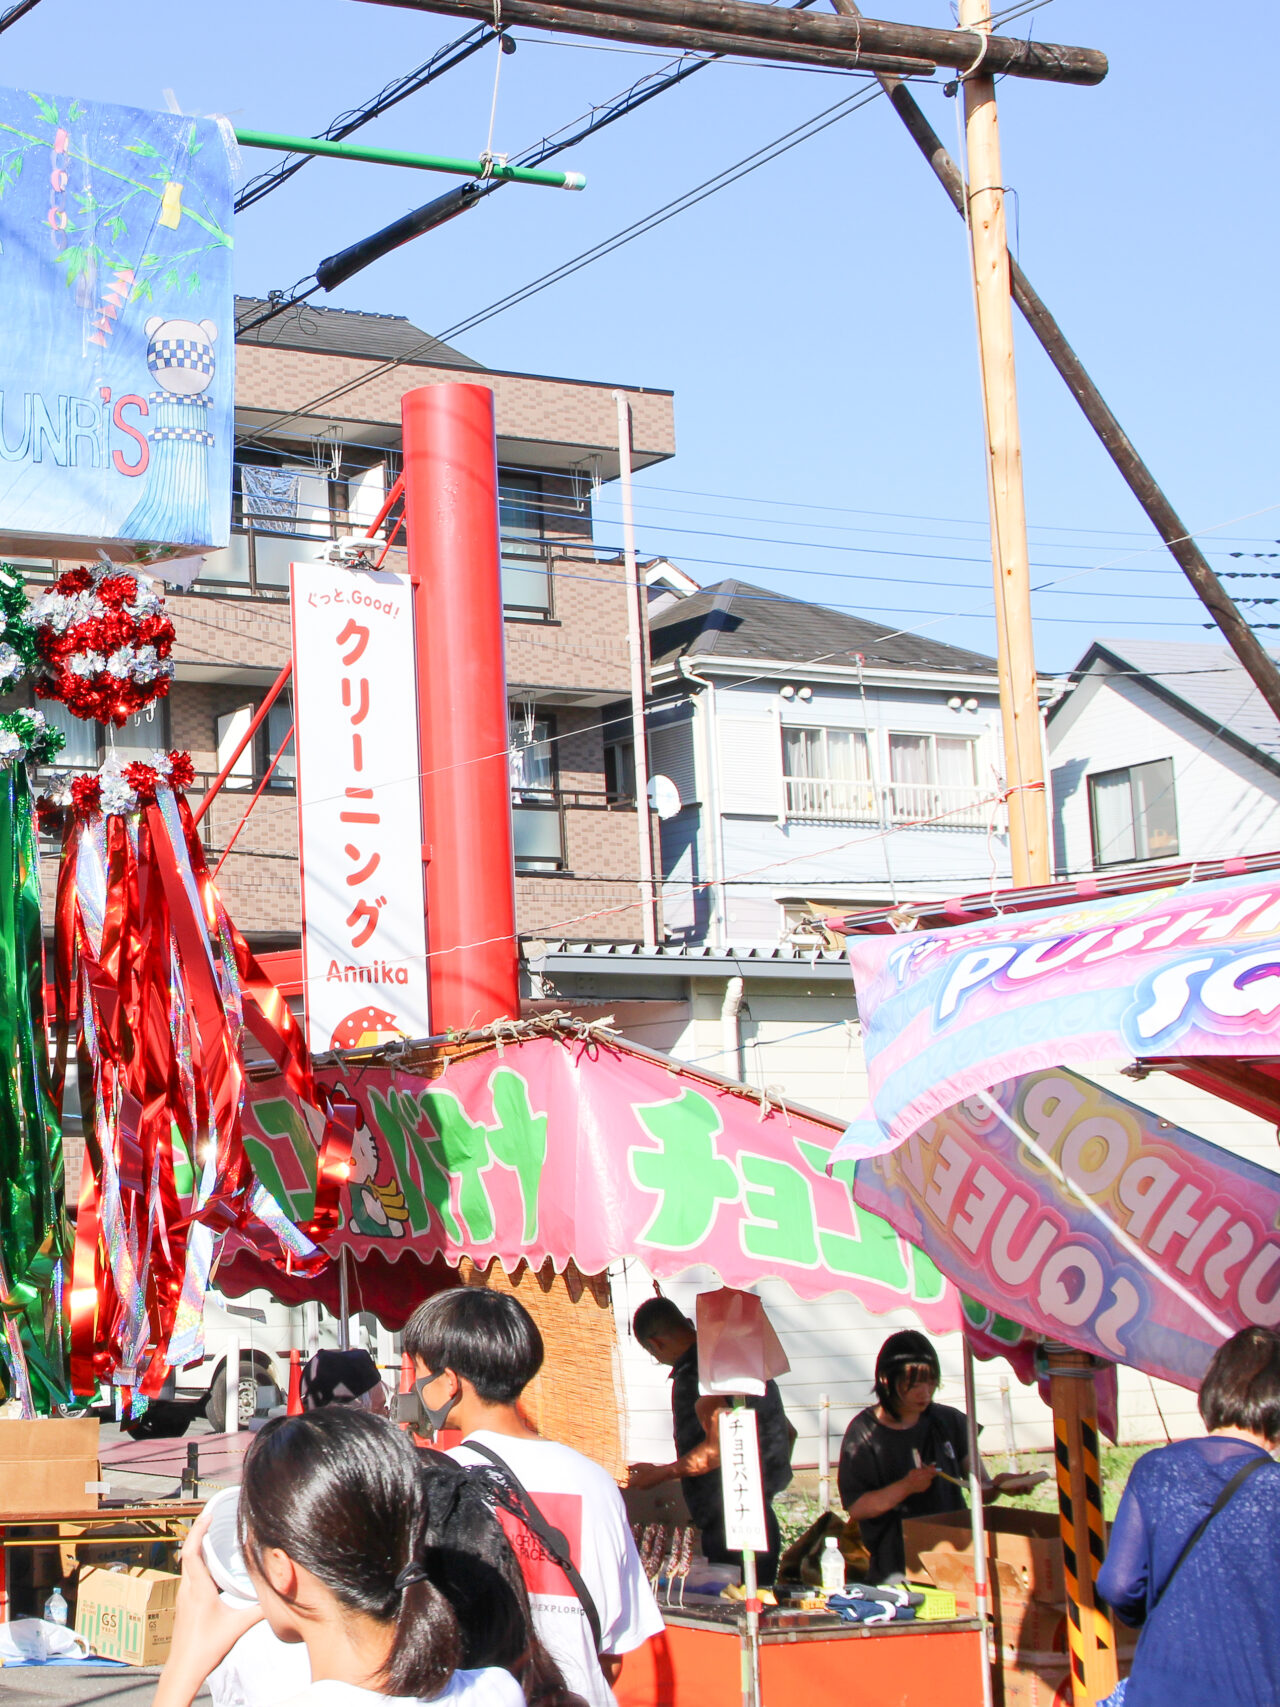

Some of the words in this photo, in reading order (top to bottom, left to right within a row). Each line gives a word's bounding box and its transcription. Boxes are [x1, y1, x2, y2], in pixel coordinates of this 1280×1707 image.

[335, 618, 387, 948] クリーニング
[326, 960, 409, 985] Annika
[939, 893, 1280, 1020] PUSH
[628, 1086, 947, 1302] チョコ
[729, 1419, 750, 1520] チョコバナナ
[101, 1612, 117, 1628] GS
